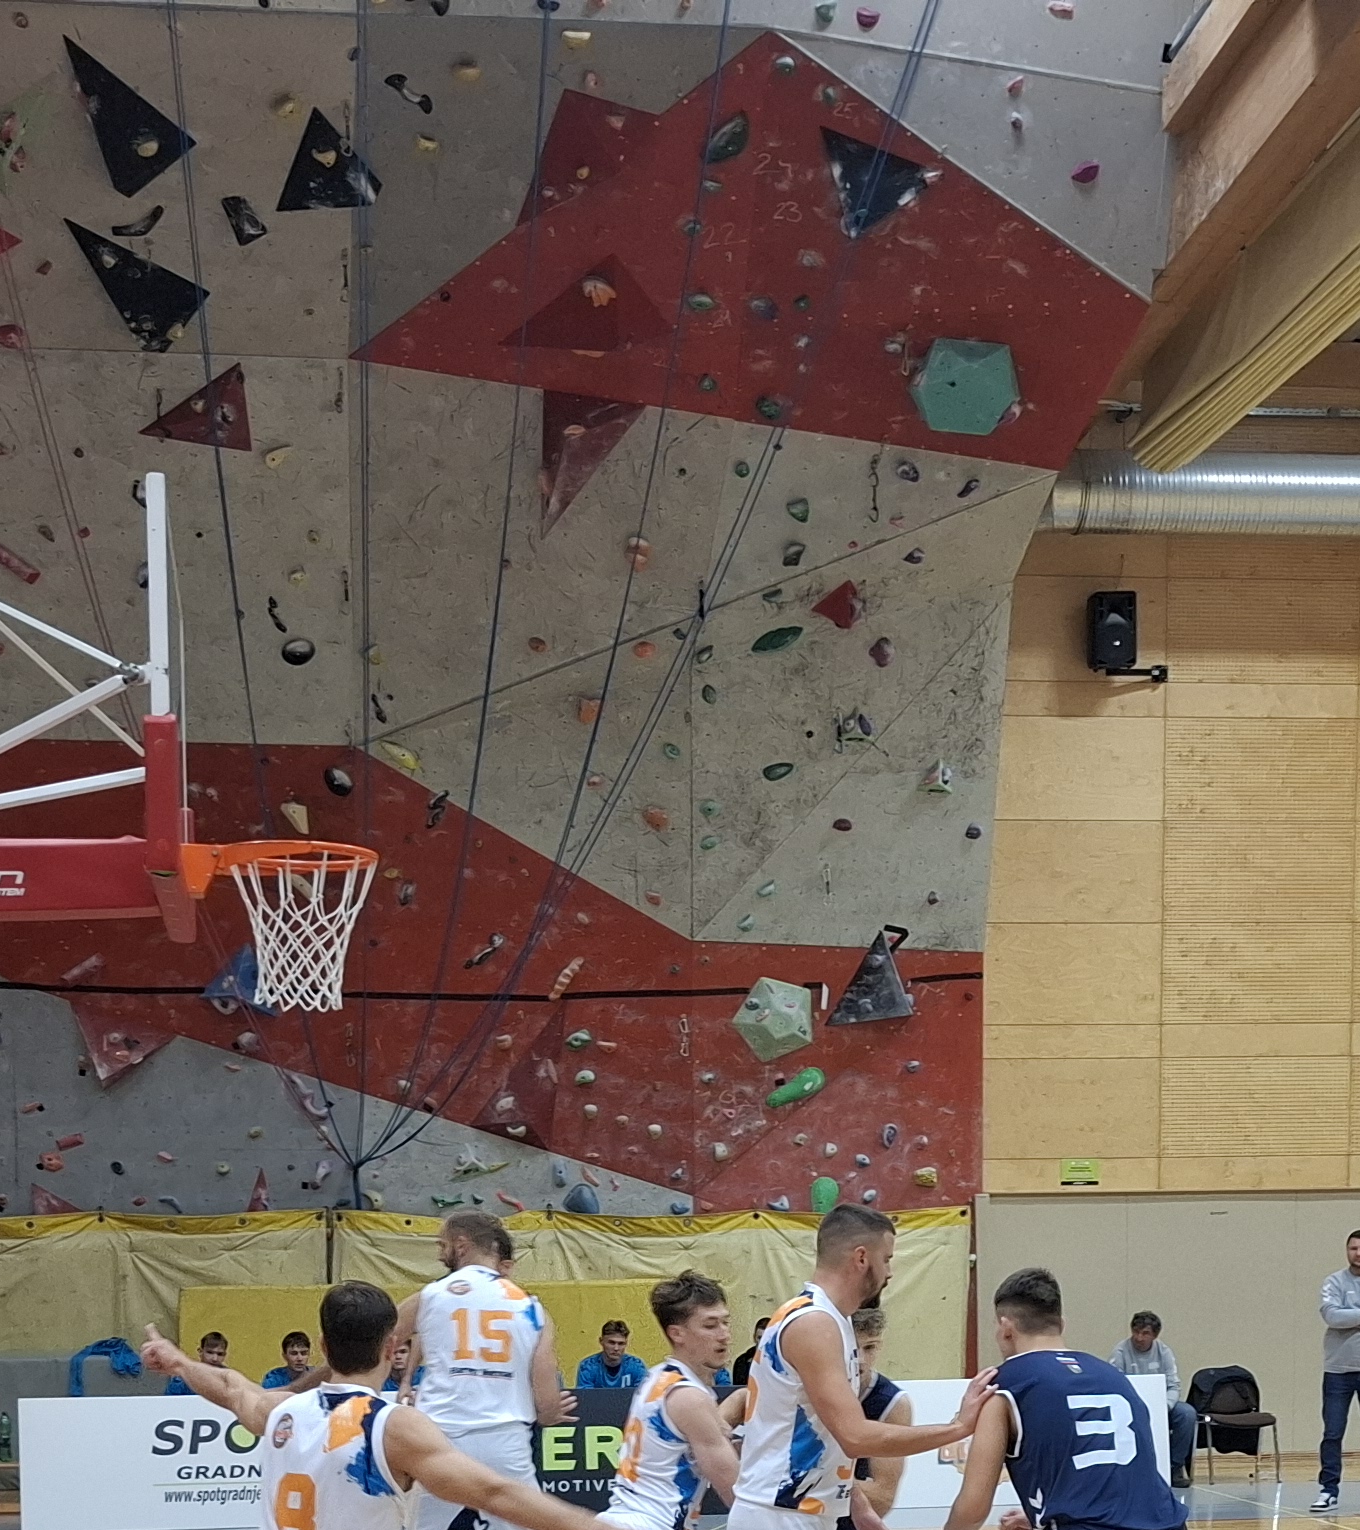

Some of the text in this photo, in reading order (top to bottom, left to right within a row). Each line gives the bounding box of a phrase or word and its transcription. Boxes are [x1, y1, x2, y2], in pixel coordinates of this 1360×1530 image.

[773, 201, 803, 223] 23
[450, 1308, 513, 1364] 15
[1066, 1393, 1138, 1471] 3
[176, 1464, 262, 1480] GRADN
